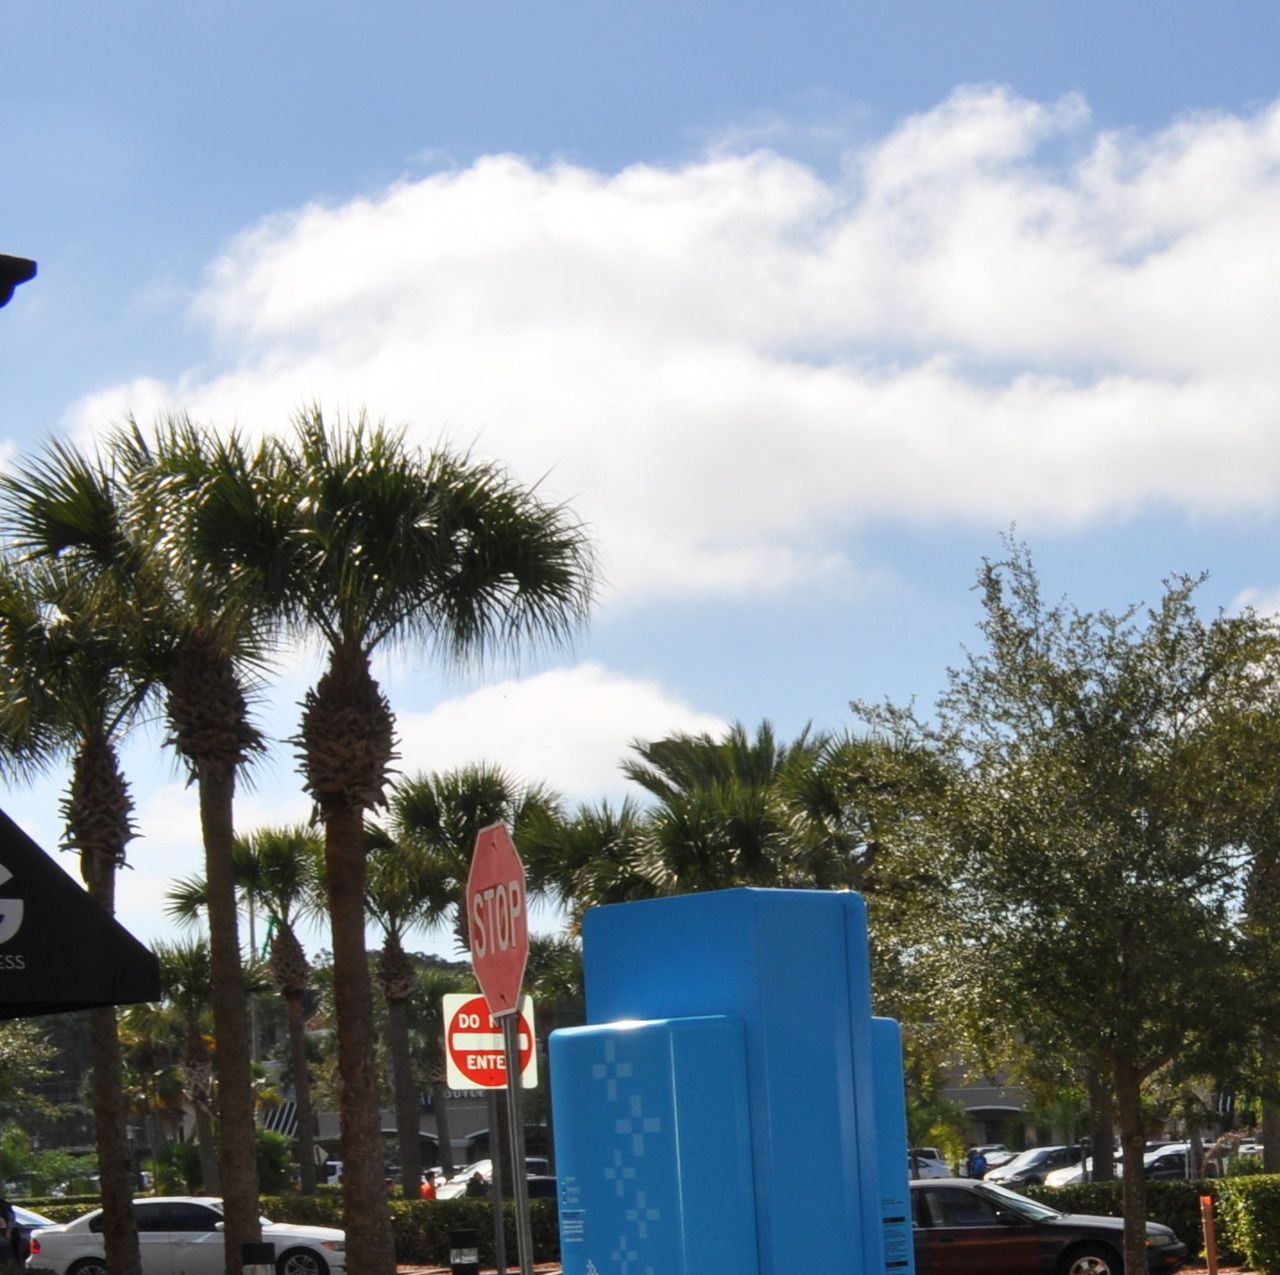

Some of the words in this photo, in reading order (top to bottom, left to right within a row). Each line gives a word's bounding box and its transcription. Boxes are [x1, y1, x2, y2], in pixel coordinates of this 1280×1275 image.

[473, 879, 521, 959] STOP
[458, 1013, 481, 1029] DO
[467, 1054, 506, 1070] ENTE
